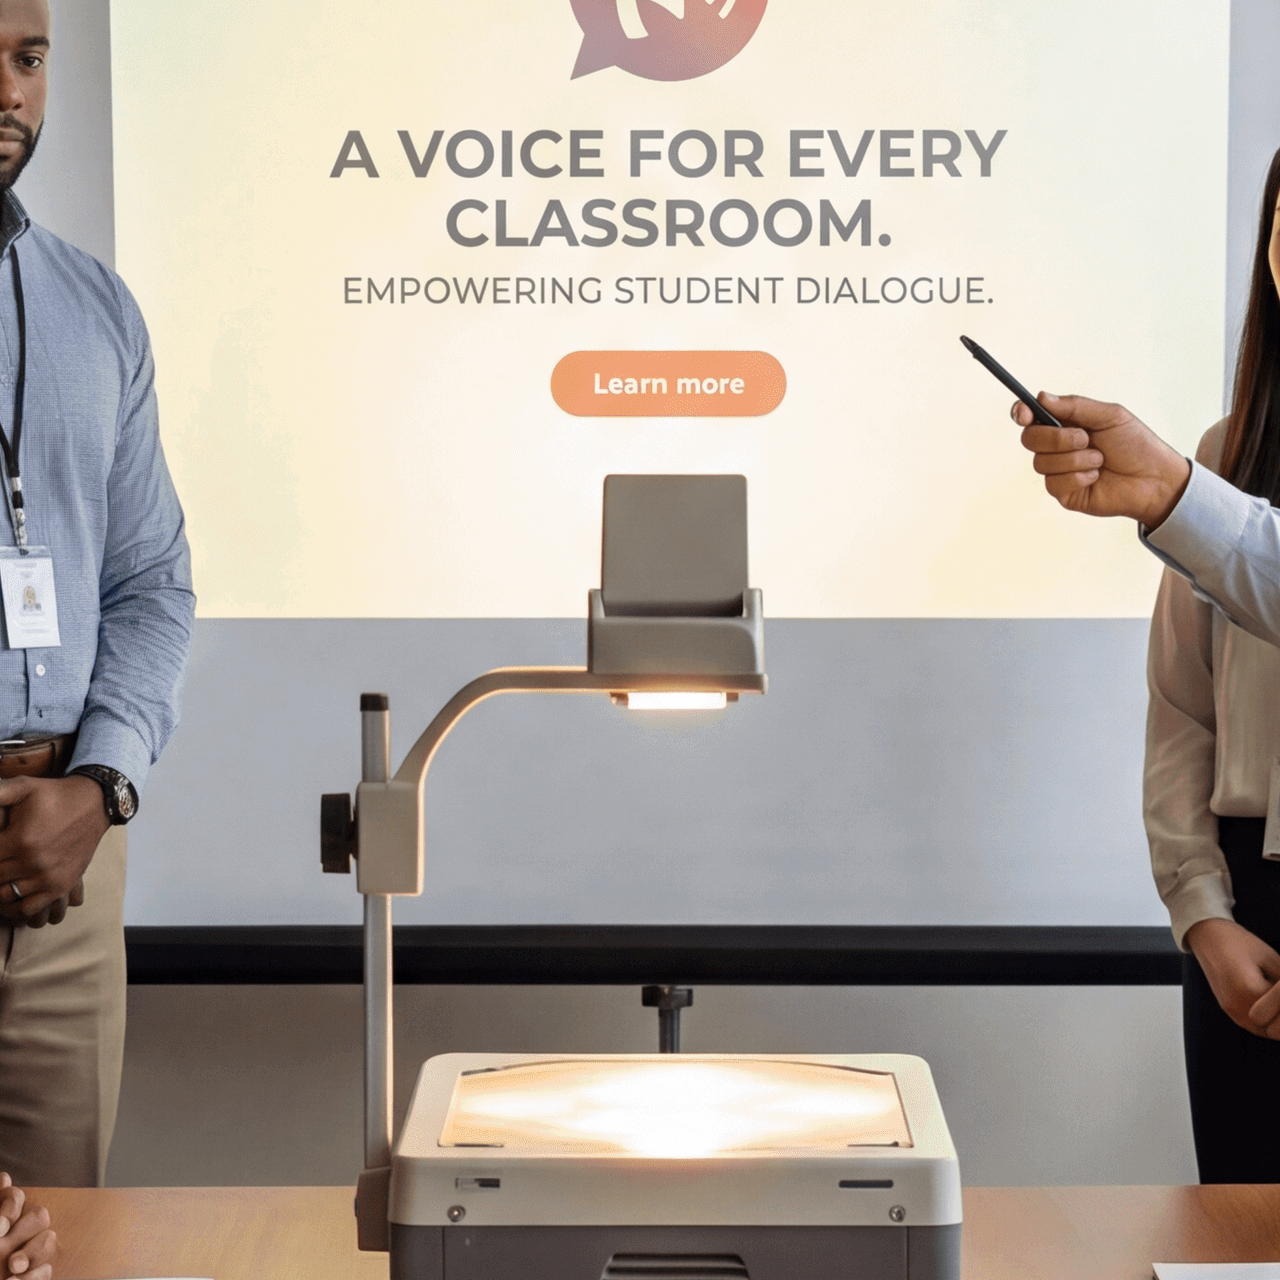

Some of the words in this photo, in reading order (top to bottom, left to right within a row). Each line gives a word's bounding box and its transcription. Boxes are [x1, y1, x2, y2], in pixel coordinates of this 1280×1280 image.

[329, 130, 380, 179] A
[396, 129, 605, 179] VOICE
[630, 129, 764, 179] FOR
[789, 129, 1009, 178] EVERY
[445, 198, 892, 248] CLASSROOM.
[344, 276, 602, 304] EMPOWERING
[614, 276, 784, 304] STUDENT
[797, 276, 994, 304] DIALOGUE.
[592, 372, 669, 395] Learn
[675, 377, 746, 395] more
